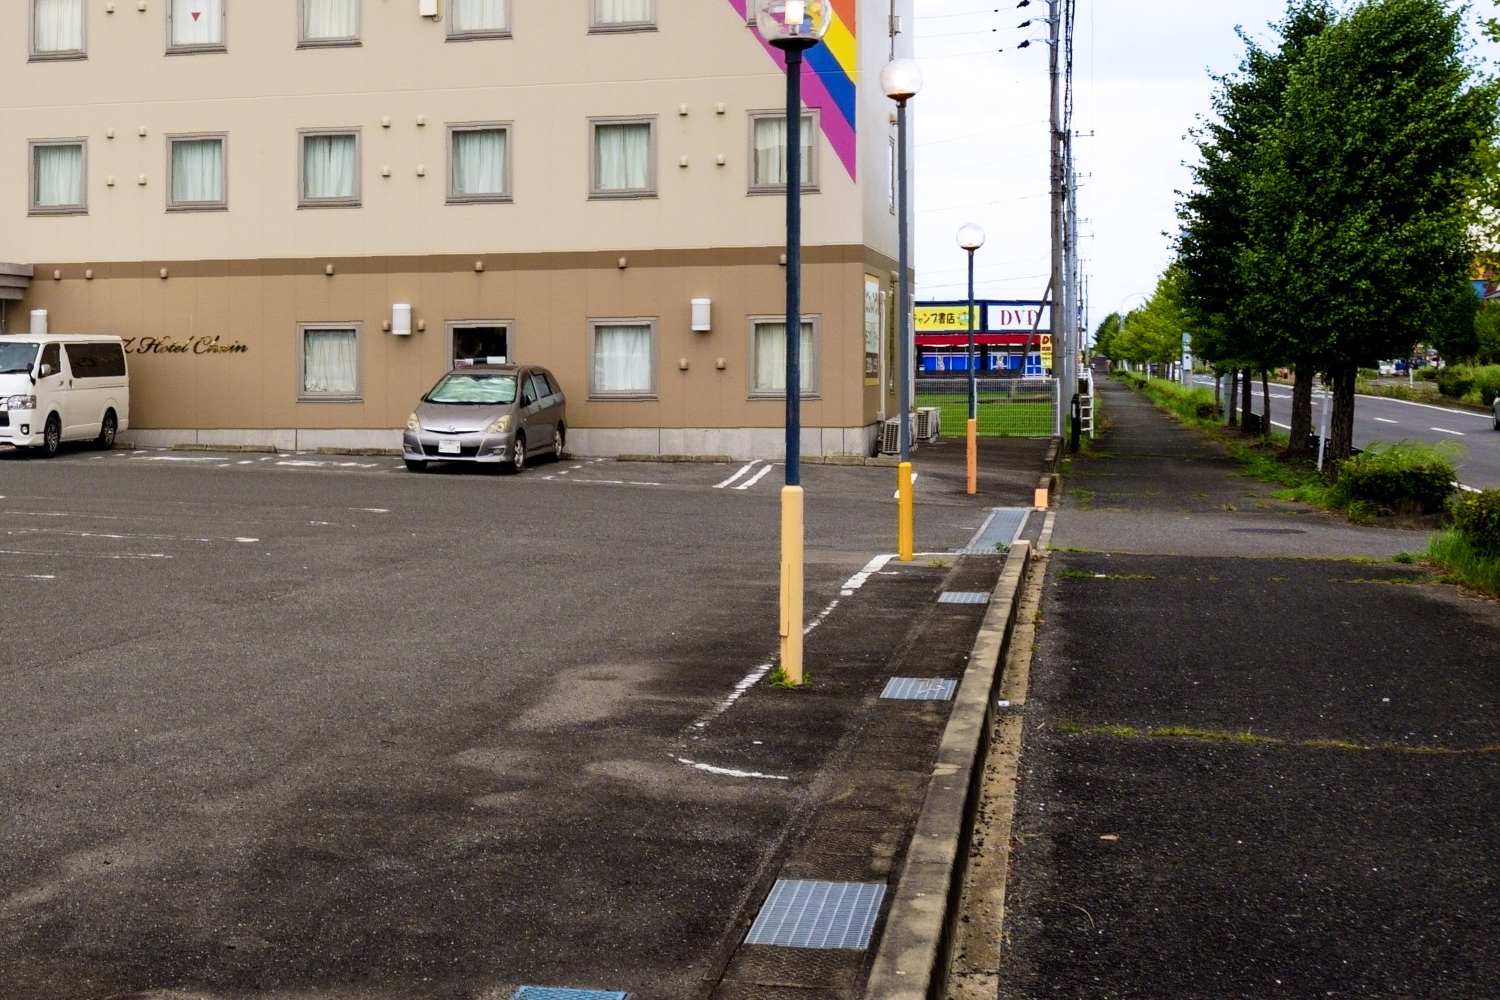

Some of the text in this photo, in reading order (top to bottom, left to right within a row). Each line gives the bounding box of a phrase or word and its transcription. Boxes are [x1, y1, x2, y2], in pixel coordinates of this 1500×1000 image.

[1000, 309, 1041, 326] DVD
[136, 335, 193, 355] Hotel
[192, 335, 249, 355] Chain
